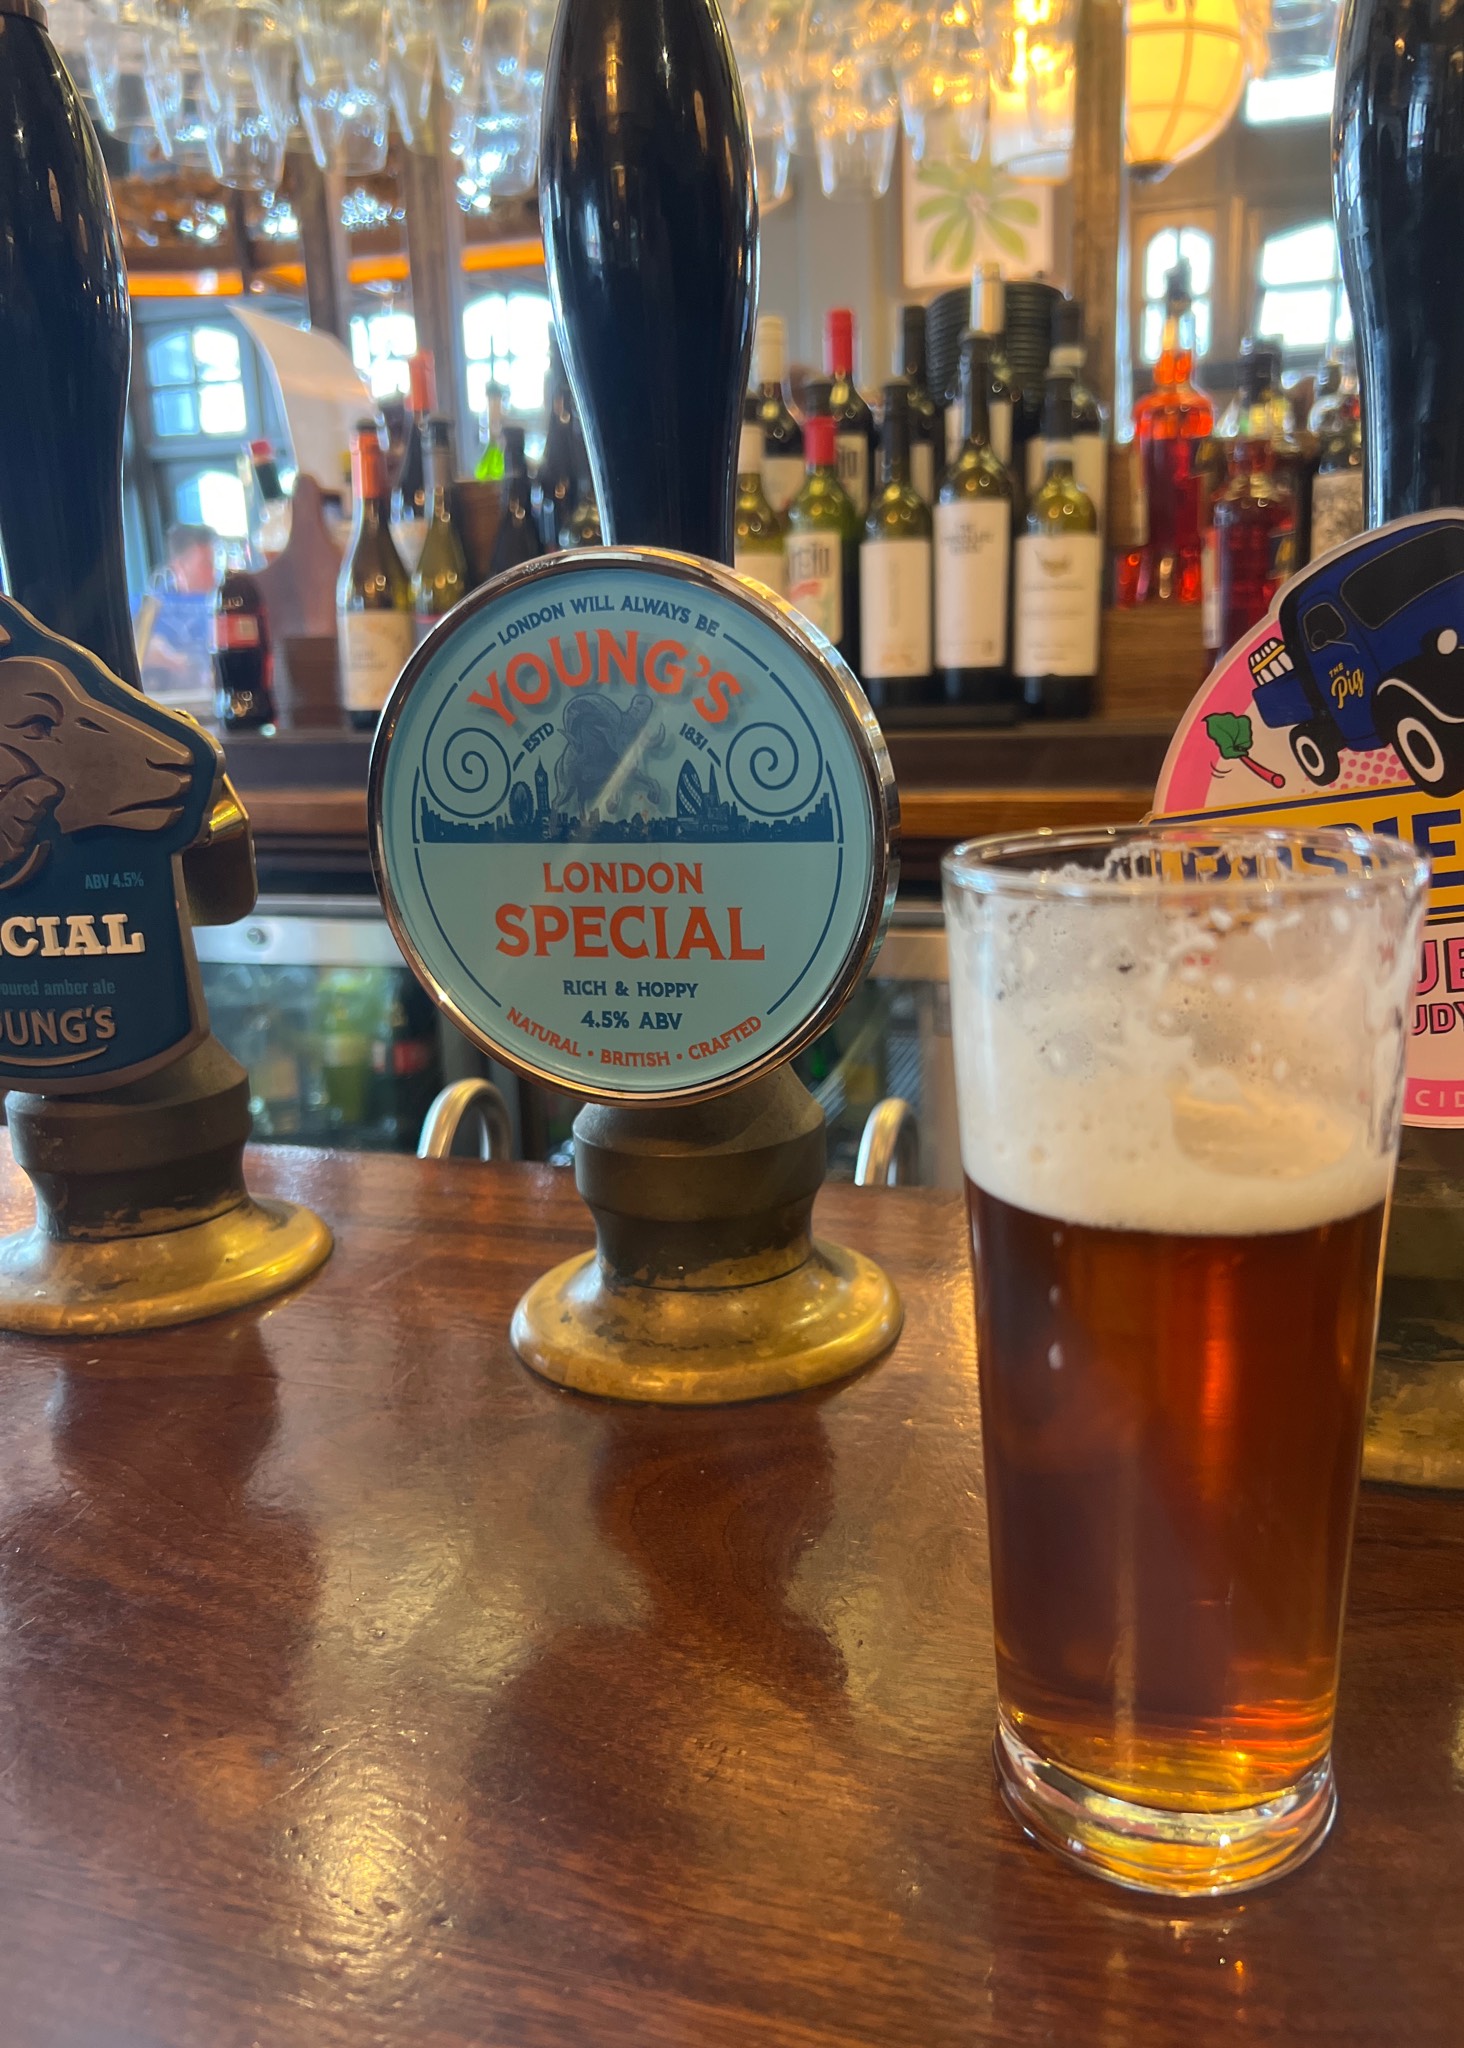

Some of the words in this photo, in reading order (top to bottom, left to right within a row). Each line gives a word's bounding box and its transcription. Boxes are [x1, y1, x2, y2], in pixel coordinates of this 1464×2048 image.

[497, 602, 565, 645] LONDON
[569, 596, 615, 614] WILL
[620, 595, 692, 624] ALWAYS
[695, 614, 720, 637] BE
[466, 628, 744, 728] YOUNG'S
[1330, 668, 1365, 709] Pig
[522, 722, 554, 754] ESTD
[679, 722, 708, 751] 1831
[85, 874, 109, 890] ABV
[112, 872, 144, 888] 4.5%
[543, 861, 704, 895] LONDON
[0, 914, 146, 957] CIAL
[494, 903, 766, 961] SPECIAL
[0, 979, 39, 996] oured
[44, 979, 88, 996] amber
[93, 978, 116, 994] ale
[563, 980, 607, 996] RICH
[614, 981, 629, 997] &
[637, 981, 699, 998] HOPPY
[0, 1004, 117, 1046] UNG'S
[506, 1007, 581, 1057] NATURAL
[600, 1049, 670, 1067] BRITISH
[688, 1015, 761, 1060] CRAFTED
[581, 1010, 630, 1029] 4.5%
[639, 1012, 682, 1030] ABV
